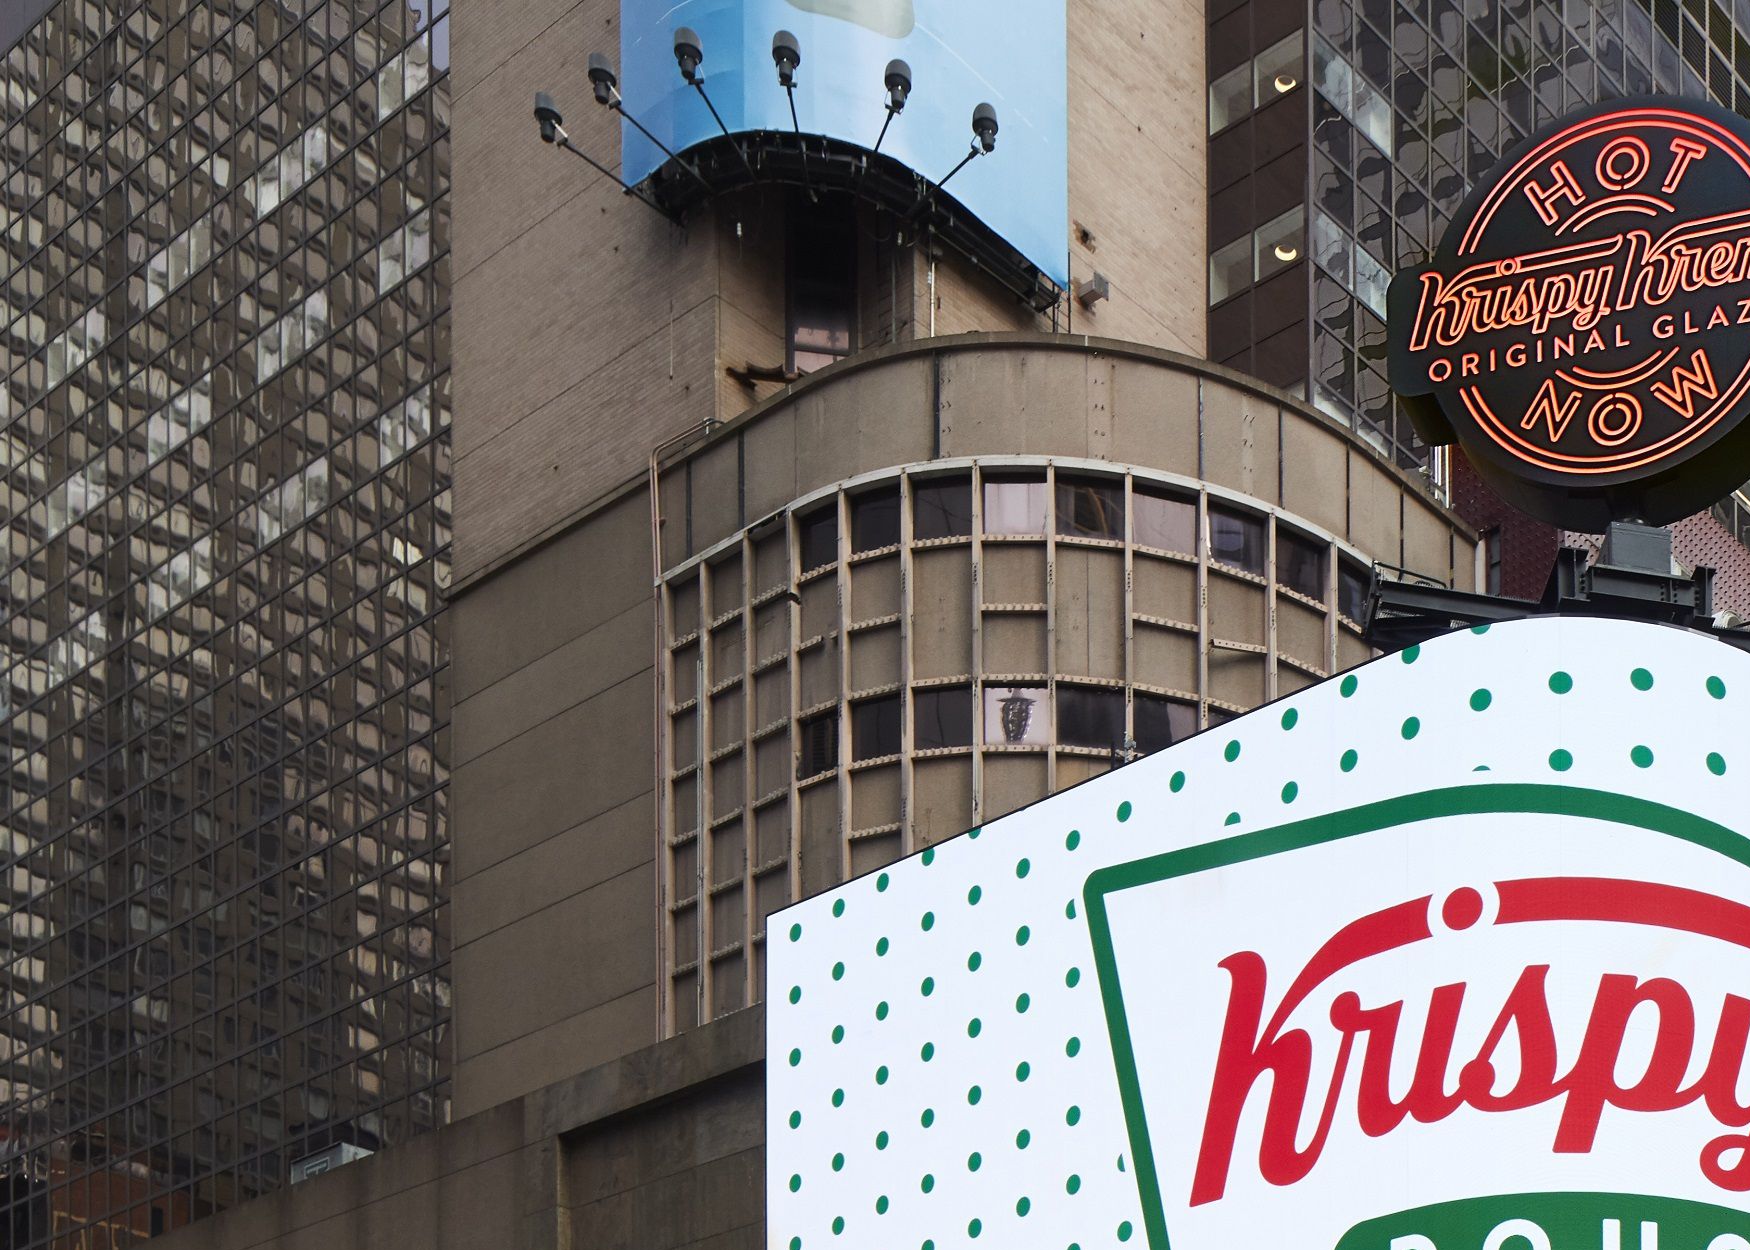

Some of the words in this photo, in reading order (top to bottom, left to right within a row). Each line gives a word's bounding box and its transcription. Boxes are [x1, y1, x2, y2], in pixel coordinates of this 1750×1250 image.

[1524, 136, 1706, 226] HOT
[1409, 233, 1623, 351] Krispy
[1428, 324, 1630, 382] ORIGINAL
[1520, 349, 1718, 446] NOW
